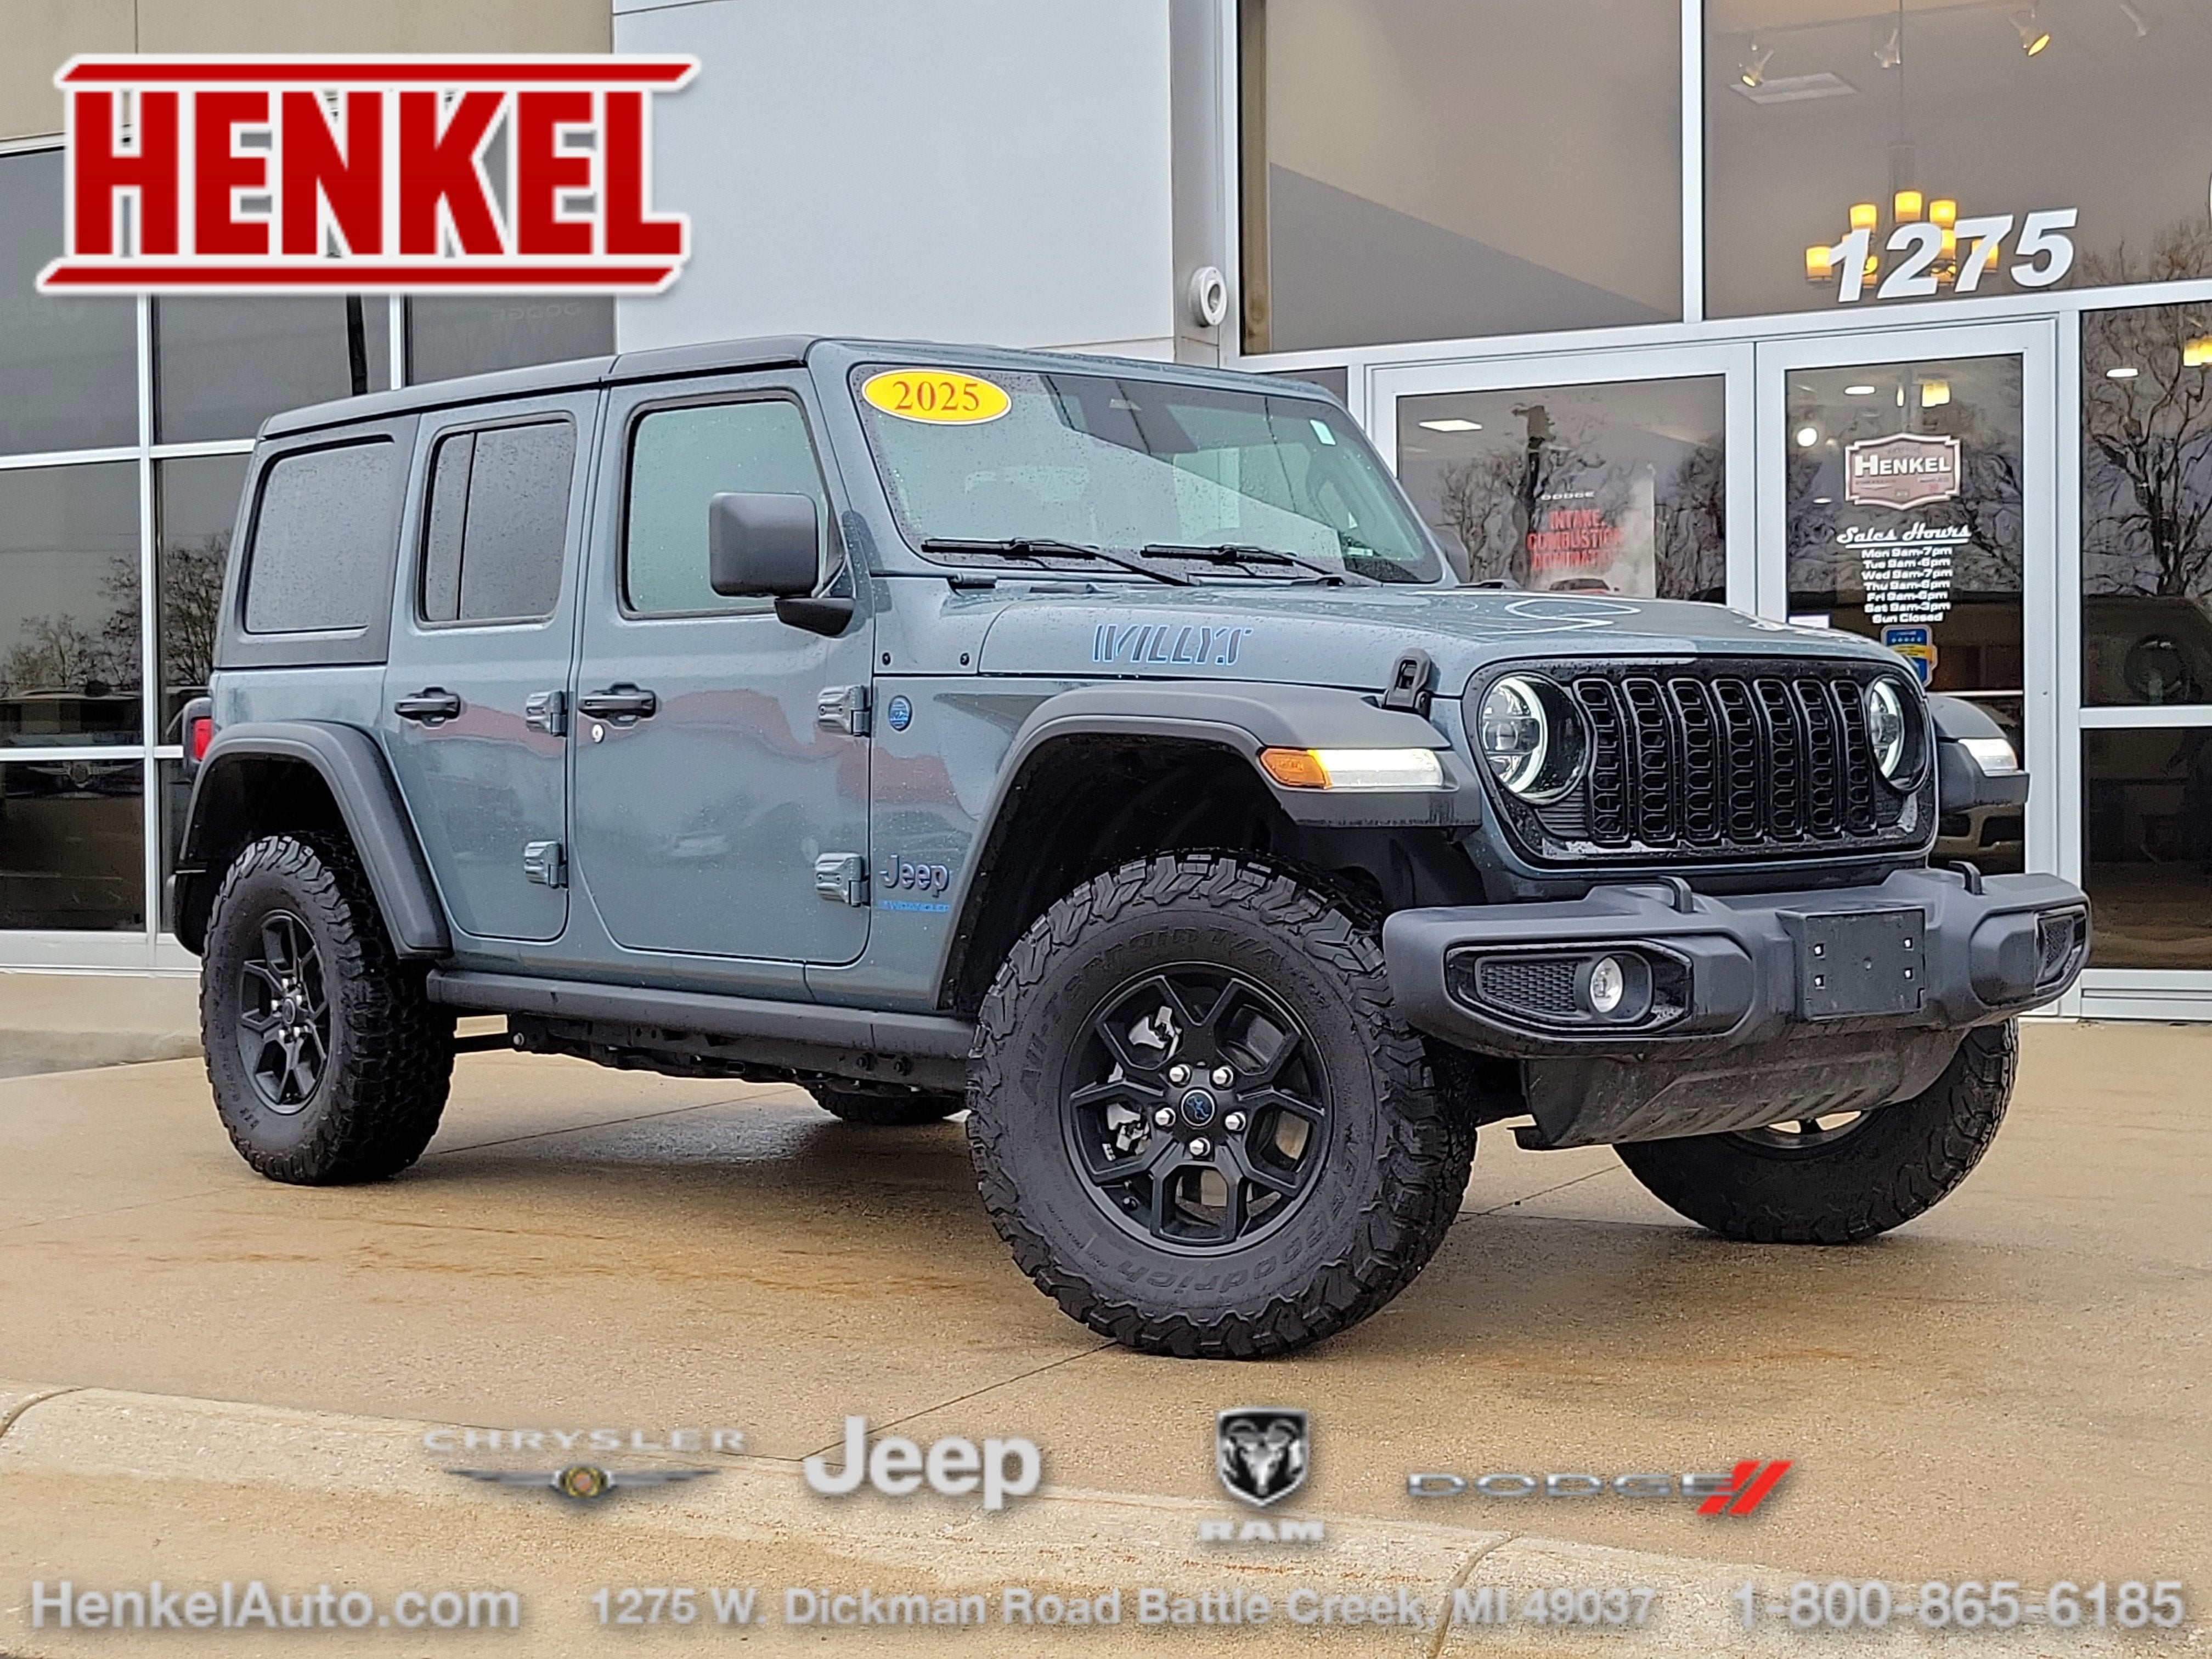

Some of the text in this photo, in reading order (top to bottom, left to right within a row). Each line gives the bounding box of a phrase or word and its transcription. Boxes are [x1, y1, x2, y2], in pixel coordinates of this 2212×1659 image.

[1827, 207, 2078, 303] 1275
[892, 381, 980, 411] 2025
[1541, 491, 1595, 500] DODGE
[1836, 521, 1972, 544] Sales Hours
[1861, 548, 1890, 558] Mon
[1863, 559, 1886, 569] Tue
[1861, 570, 1891, 580] Wed
[1864, 581, 1888, 591] Thu
[1866, 592, 1886, 602] Fri
[1864, 603, 1888, 613] Sat
[1872, 612, 1944, 624] Sun Closed
[1092, 624, 1253, 666] WILLYS
[879, 853, 950, 898] Jeep
